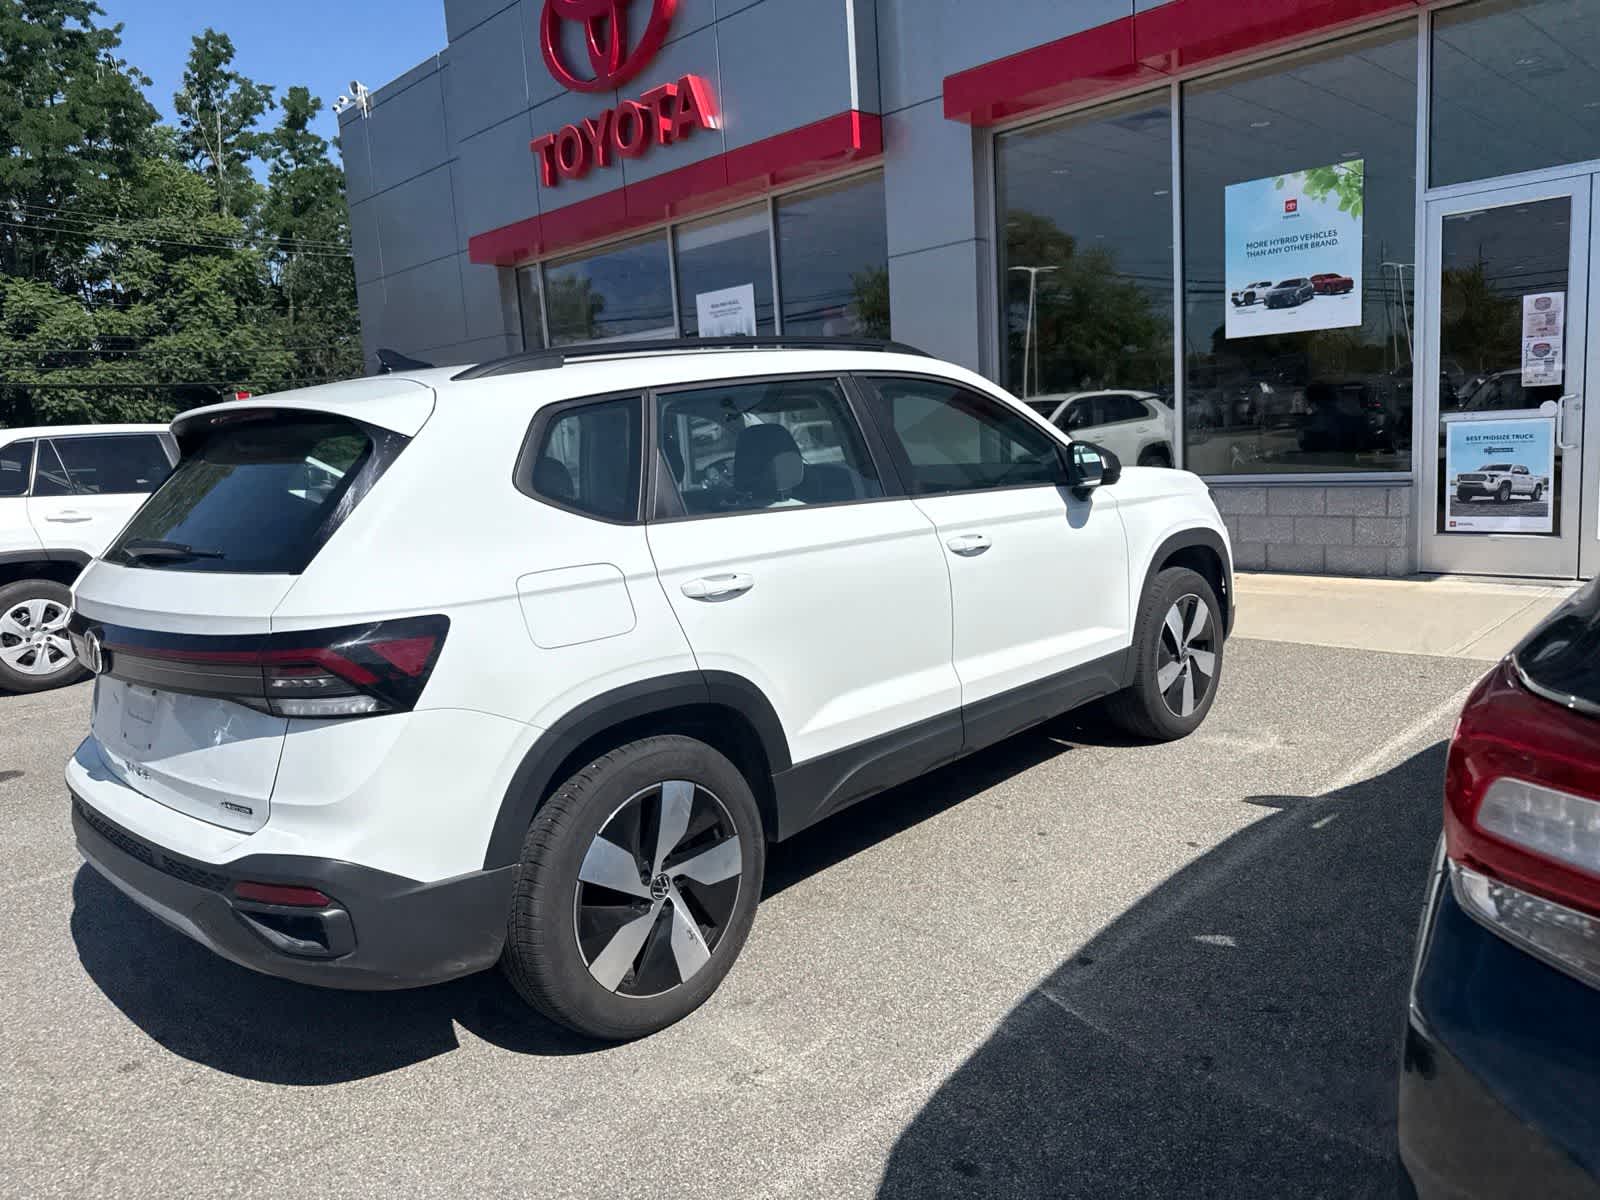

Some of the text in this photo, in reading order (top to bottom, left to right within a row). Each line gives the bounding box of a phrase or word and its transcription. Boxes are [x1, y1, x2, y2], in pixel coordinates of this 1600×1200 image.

[530, 74, 721, 187] TOYOTA
[1246, 229, 1338, 250] MORE HYBRID VEHICLES
[1246, 249, 1266, 258] THAN
[1267, 246, 1283, 255] ANY
[1284, 243, 1309, 253] OTHER
